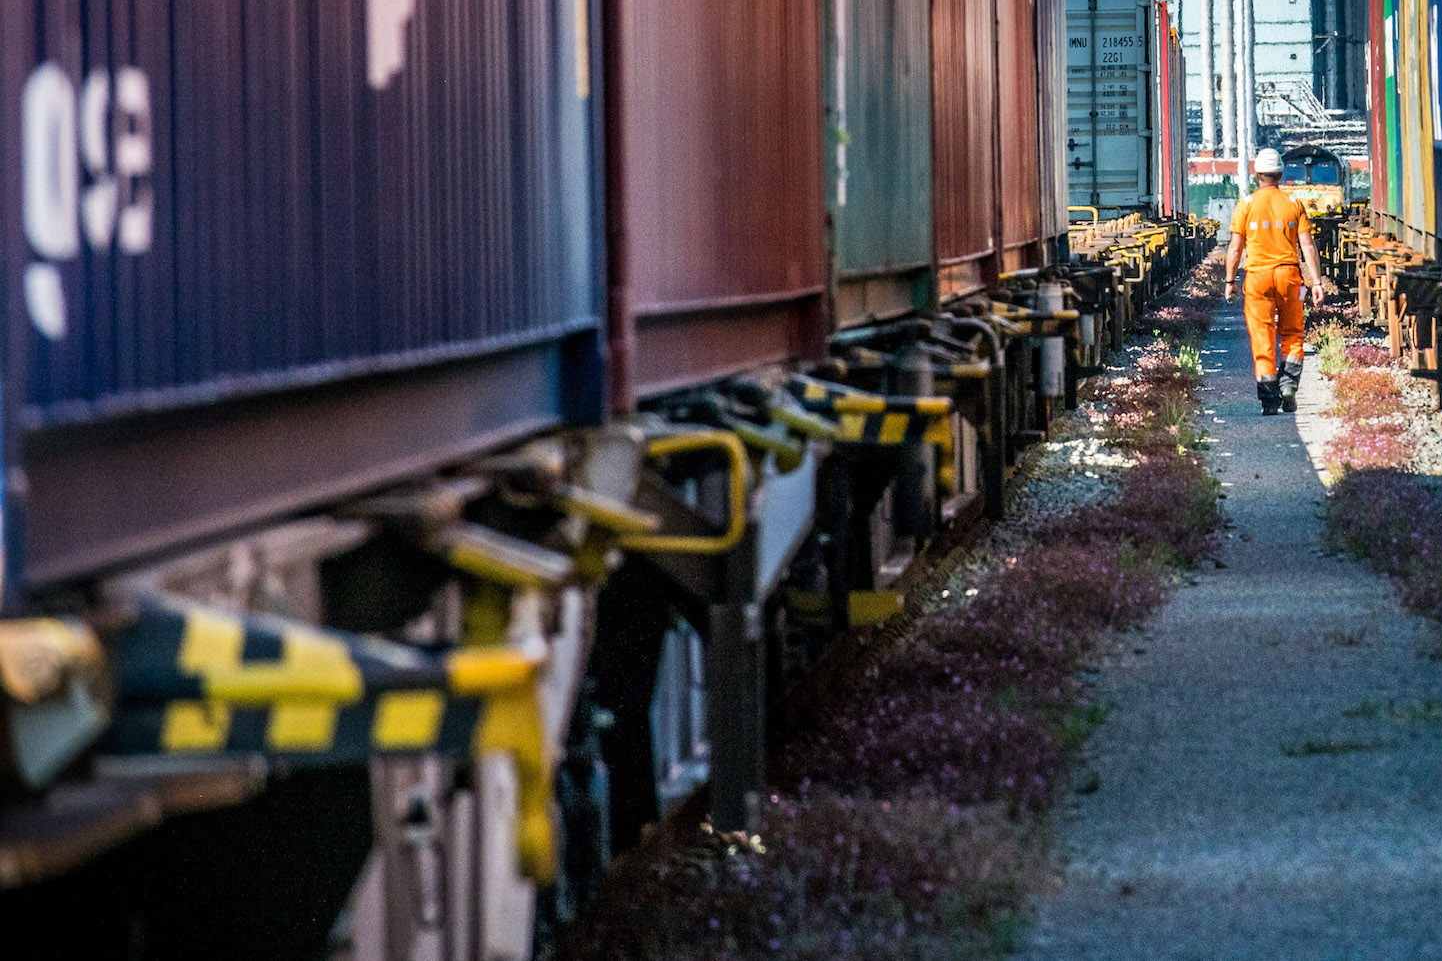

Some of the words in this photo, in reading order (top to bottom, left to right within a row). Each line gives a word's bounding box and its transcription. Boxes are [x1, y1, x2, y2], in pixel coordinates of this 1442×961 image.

[1102, 36, 1134, 48] 218455
[1138, 36, 1144, 47] 5
[1102, 52, 1123, 63] 22G1
